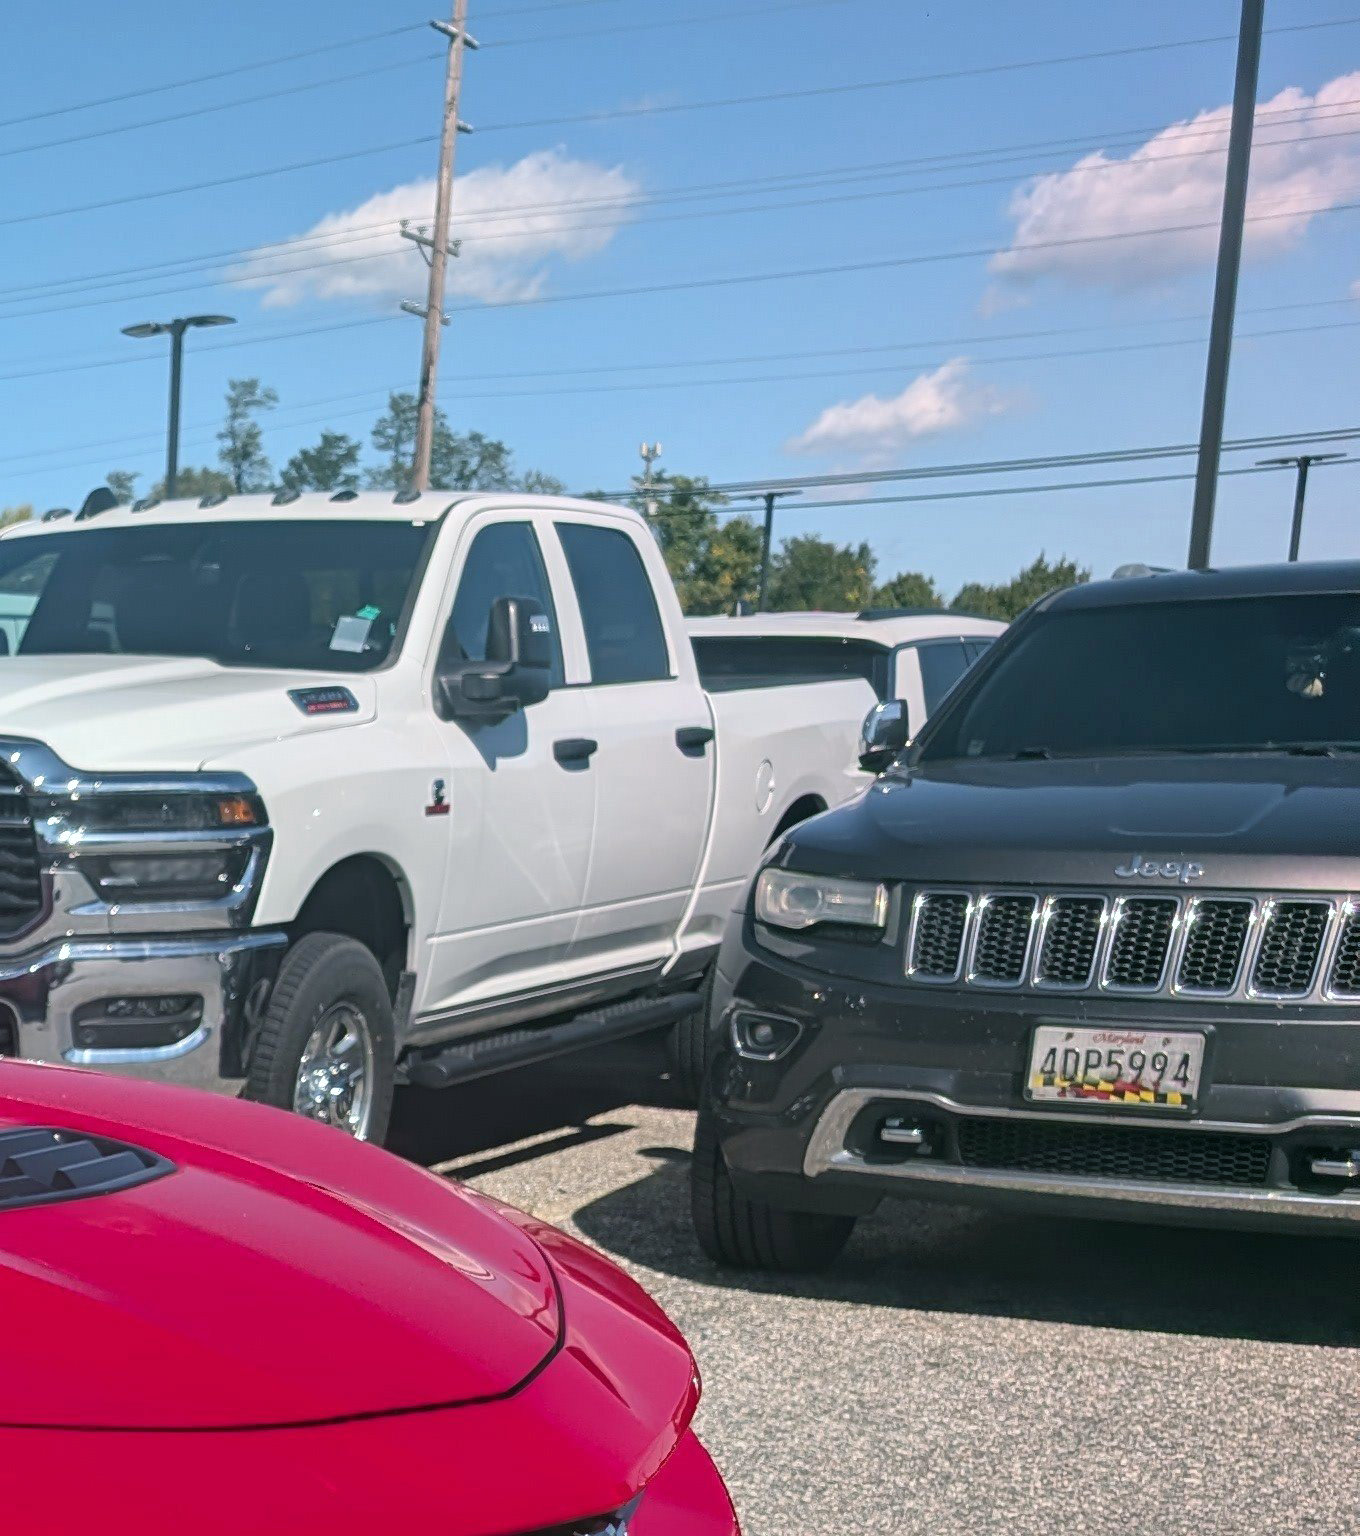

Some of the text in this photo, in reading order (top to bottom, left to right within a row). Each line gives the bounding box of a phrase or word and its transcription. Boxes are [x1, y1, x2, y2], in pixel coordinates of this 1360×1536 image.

[1114, 854, 1204, 884] Jeep
[1092, 1031, 1147, 1047] Maryland
[1040, 1047, 1193, 1088] 4DP5994
